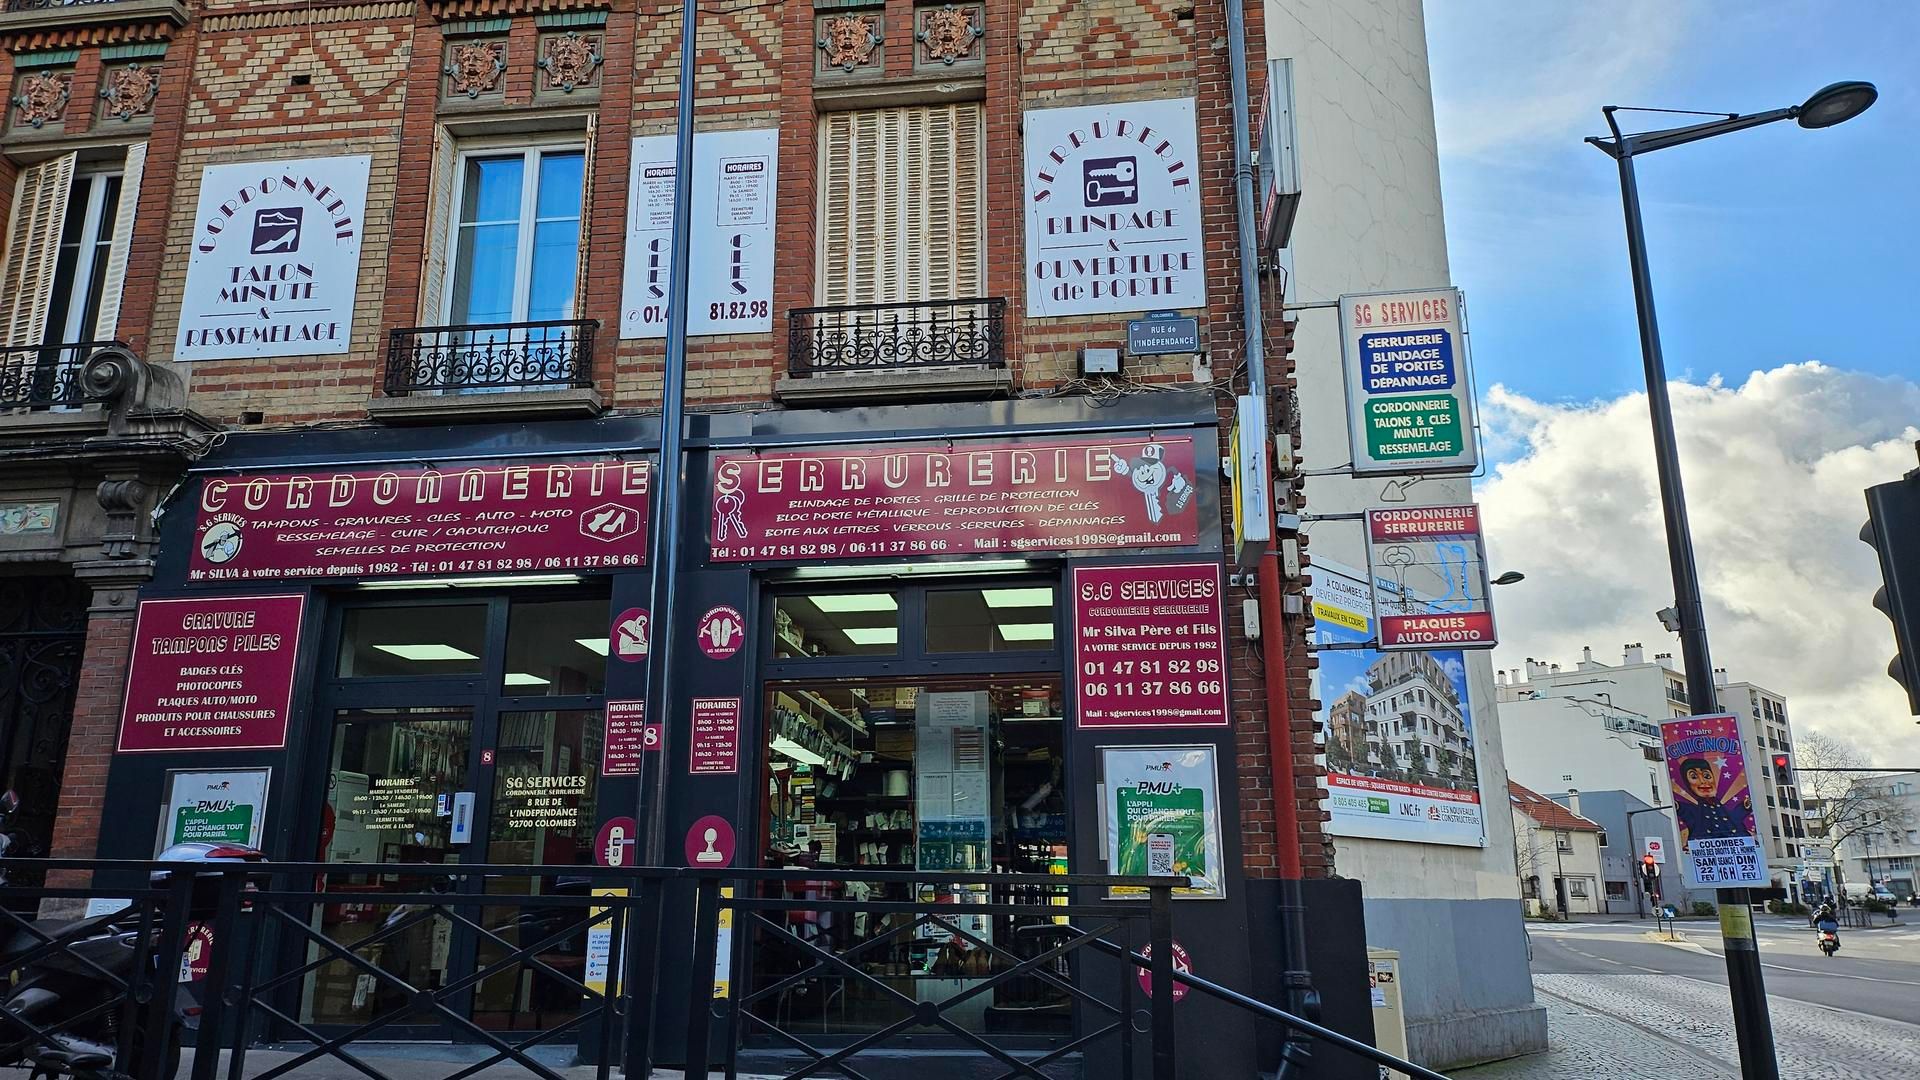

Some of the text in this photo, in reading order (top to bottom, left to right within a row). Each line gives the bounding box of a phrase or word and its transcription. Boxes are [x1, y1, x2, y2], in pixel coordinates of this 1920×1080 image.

[727, 163, 762, 172] HORAIRES
[1033, 119, 1191, 203] SERRURERIE
[199, 175, 355, 254] CORDONNERIE
[1047, 209, 1181, 235] BLINDAGE
[1107, 238, 1120, 252] &
[647, 238, 670, 299] CLES
[729, 234, 752, 295] CLES
[1034, 252, 1196, 280] OUVERTURE
[229, 262, 314, 284] TALON
[216, 281, 320, 304] MINUTE
[1051, 276, 1181, 301] de PORTE
[256, 306, 272, 320] &
[709, 301, 768, 320] 81.82.98
[1355, 299, 1449, 325] SG SERVICES
[185, 322, 341, 347] RESSEMELAGE
[1151, 325, 1176, 334] RUE de
[1367, 334, 1443, 348] SERRURERIE
[1372, 349, 1440, 363] BLINDAGE
[1370, 360, 1445, 374] DE PORTES
[1370, 374, 1448, 389] DÉPANNAGE
[1372, 399, 1450, 414] CORDONNERIE
[1374, 413, 1451, 428] TALONS & CLÉS
[1393, 427, 1434, 439] MINUTE
[1379, 441, 1452, 455] RESSEMELAGE
[717, 447, 1111, 494] SERRURERIE
[202, 461, 649, 512] CORDONNERIE
[789, 489, 1080, 509] BLINDAGE DE PORTES GRILLE DE PROTECTION
[251, 509, 573, 529] TAMPONS GRAVURES CLES AUTO MOTO
[775, 501, 1100, 523] BLOC PORTE MÉTALLIQUE REPRODUCTION DE CLÉS
[1372, 507, 1474, 522] CORDONNERIE
[213, 513, 248, 528] SERVICES
[1384, 520, 1465, 534] SERRURERIE
[277, 524, 549, 542] RESSEMELAGE CUIR CAOUTCHOUC
[765, 527, 801, 537] BOITE
[803, 526, 830, 536] AUX
[833, 525, 880, 535] LETTRES
[893, 522, 951, 533] VERROUS
[974, 532, 1182, 549] Mail sgservices1998@gmail.com
[315, 541, 506, 557] SEMELLES DE PROTECTION
[190, 562, 398, 580] Mr SILVA à votre service depuis 1982
[1081, 579, 1215, 601] S.G SERVICES
[1089, 604, 1209, 616] CORDONNERIE SERRURERIE
[1317, 607, 1365, 628] TRAVAUX COURS
[182, 611, 255, 630] GRAVURE
[1403, 617, 1466, 630] PLAQUES
[1083, 623, 1217, 637] Mr Silva Père et Fils
[1397, 630, 1481, 643] AUTO-MOTO
[152, 634, 281, 655] TAMPONS PILES
[1092, 644, 1119, 652] VOTRE
[1122, 643, 1157, 651] SERVICE
[1160, 642, 1191, 650] DEPUIS
[1194, 641, 1217, 649] 1982
[180, 663, 244, 676] BADGES CLÉS
[1084, 659, 1219, 675] 01 47 81 82 98
[176, 681, 243, 691] PHOTOCOPIES
[1085, 680, 1221, 696] 06 11 37 86 66
[157, 695, 257, 707] PLAQUES AUTO/MOTO
[696, 701, 737, 709] HORAIRES
[136, 709, 276, 722] PRODUITS POUR CHAUSSURES
[1086, 708, 1221, 718] Mail sgservices1998@gmail.com
[164, 726, 242, 737] ET ACCESSOIRES
[644, 727, 658, 745] 8
[1667, 736, 1738, 759] GUIGNOL
[483, 752, 491, 761] 8
[375, 778, 415, 787] HORAIRES
[506, 775, 587, 788] SG SERVICES
[527, 798, 532, 806] 8
[534, 798, 550, 806] RUE
[1400, 803, 1420, 816] LNC.fr
[509, 808, 578, 817] L'INDEPENDANCE
[509, 819, 577, 828] 92700 COLOMBES
[1699, 839, 1744, 848] COLOMBES
[1695, 858, 1717, 867] SAM
[1736, 855, 1756, 864] DIM
[1720, 866, 1736, 880] 16 H
